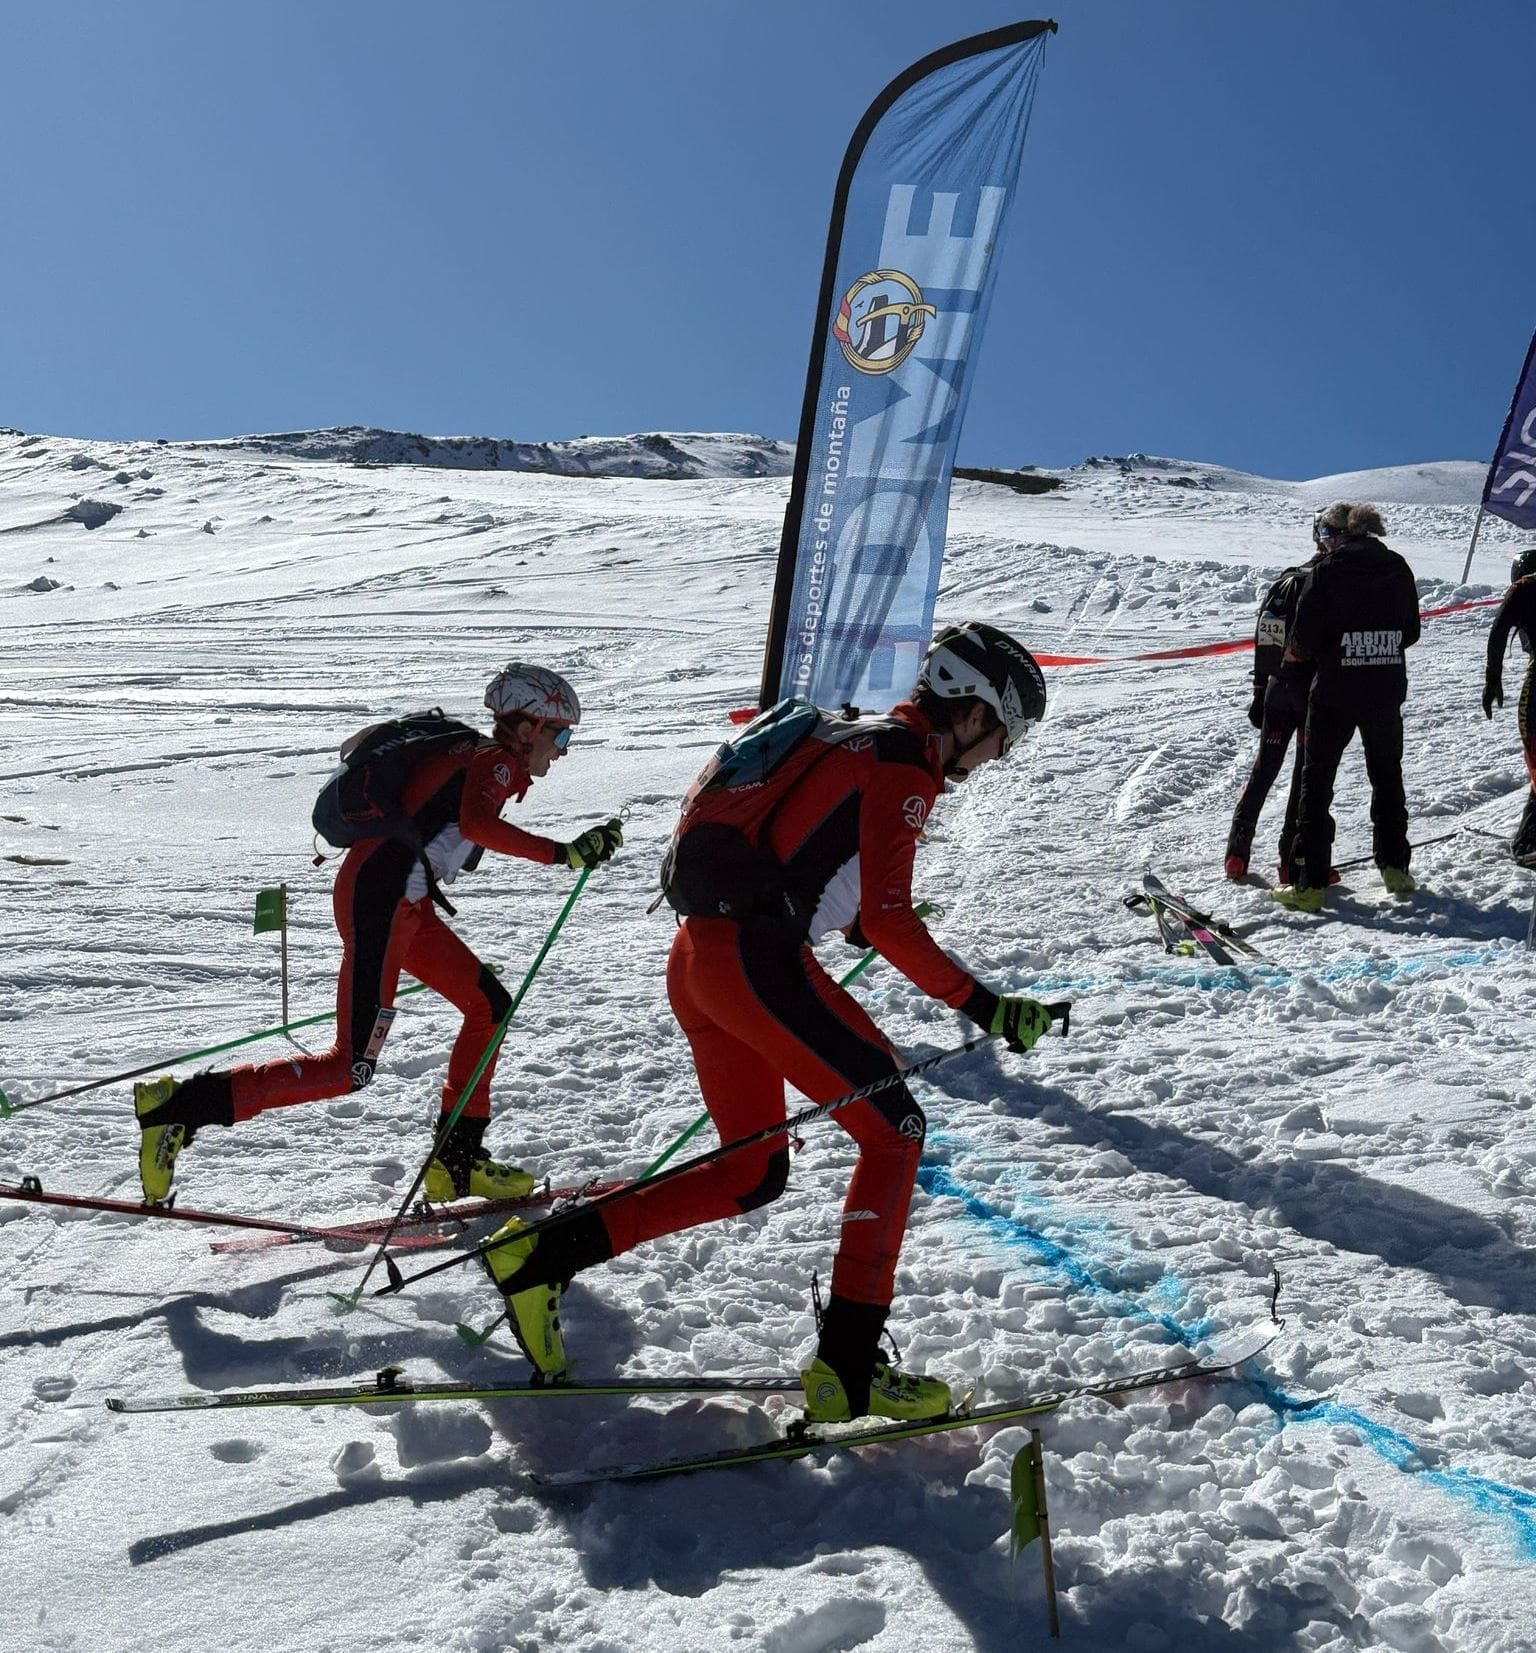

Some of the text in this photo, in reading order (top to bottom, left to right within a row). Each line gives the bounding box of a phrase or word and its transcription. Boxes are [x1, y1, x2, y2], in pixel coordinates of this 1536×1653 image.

[812, 184, 1007, 712] EDME
[823, 386, 851, 495] montaña
[813, 503, 834, 533] de
[799, 539, 828, 646] deportes
[1340, 630, 1403, 647] ARBITRO
[1345, 644, 1400, 658] FEDME
[792, 654, 813, 686] los
[994, 641, 1046, 698] DYNAFIT
[1026, 1365, 1188, 1406] DYNAFIT
